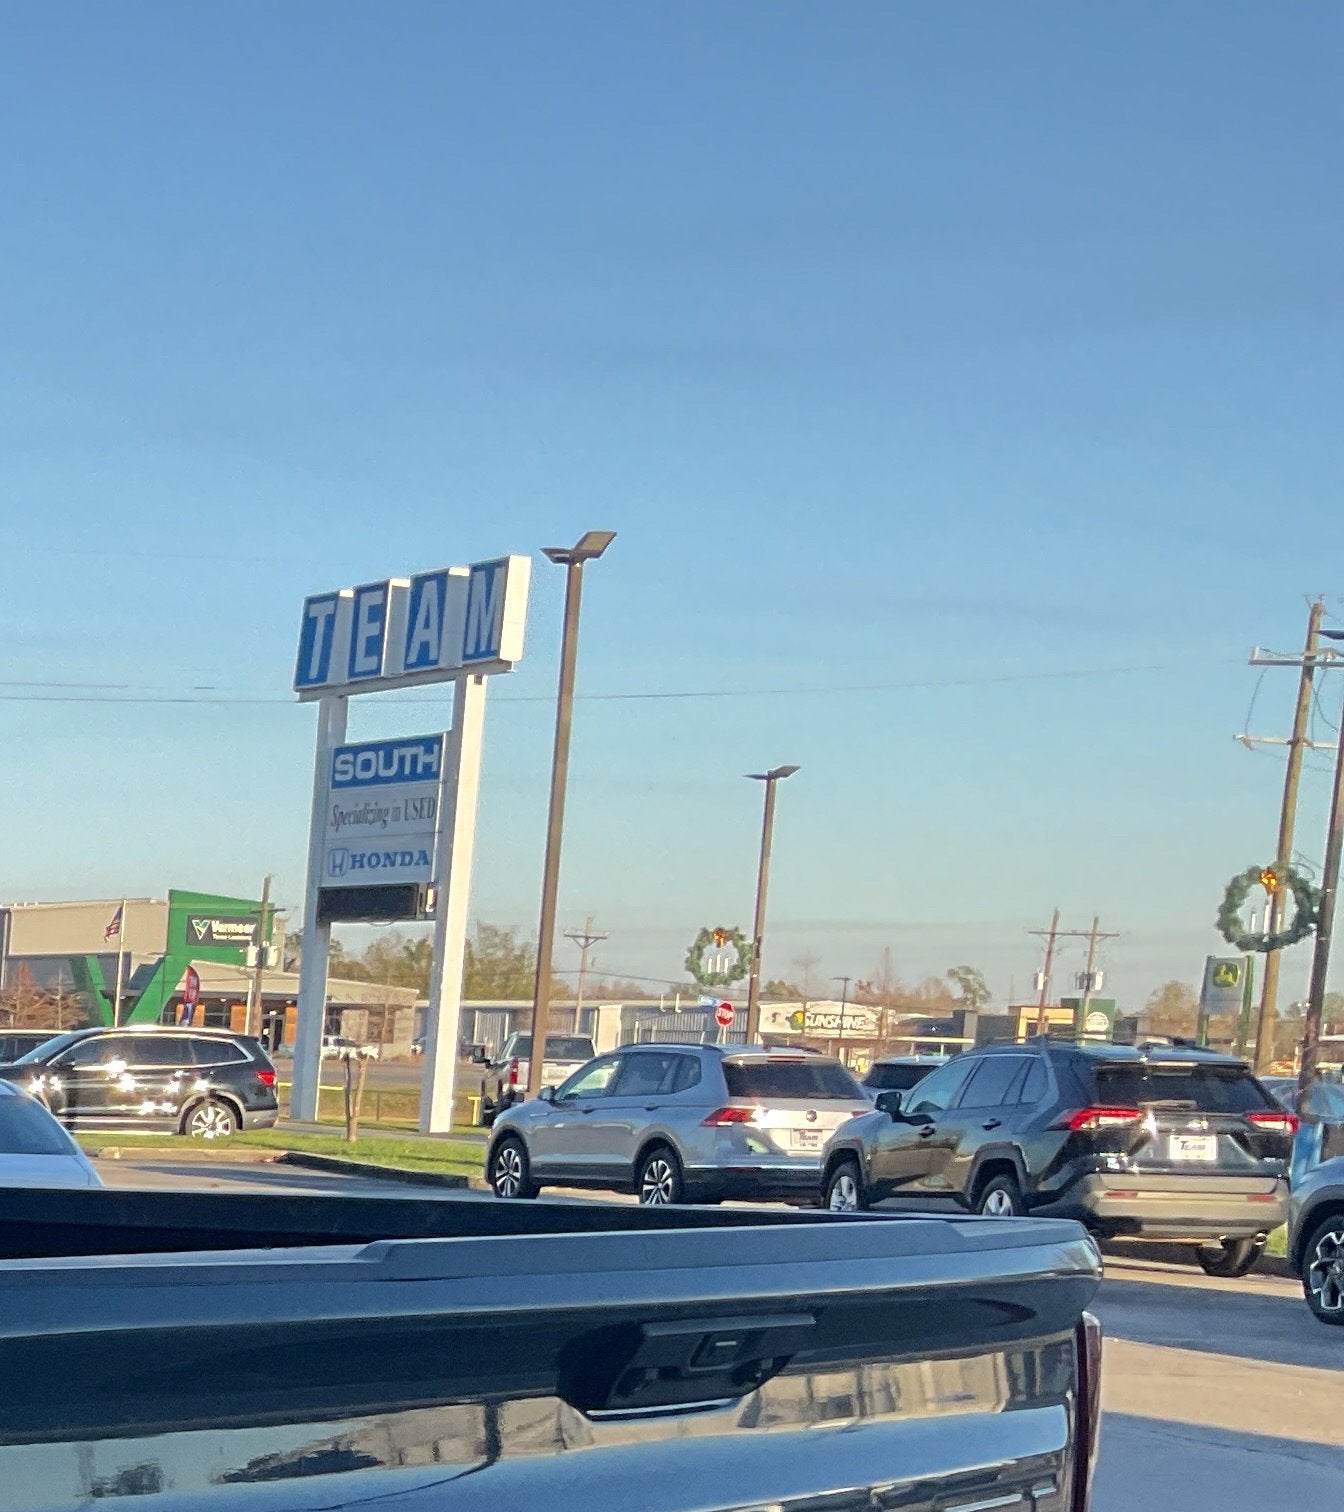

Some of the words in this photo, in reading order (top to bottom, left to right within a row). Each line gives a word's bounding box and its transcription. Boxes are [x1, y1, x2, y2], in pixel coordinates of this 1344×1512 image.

[308, 564, 504, 680] TEAM
[333, 743, 440, 782] SOUTH
[331, 801, 390, 833] Specializing
[403, 796, 436, 822] USED
[350, 849, 430, 870] HONDA
